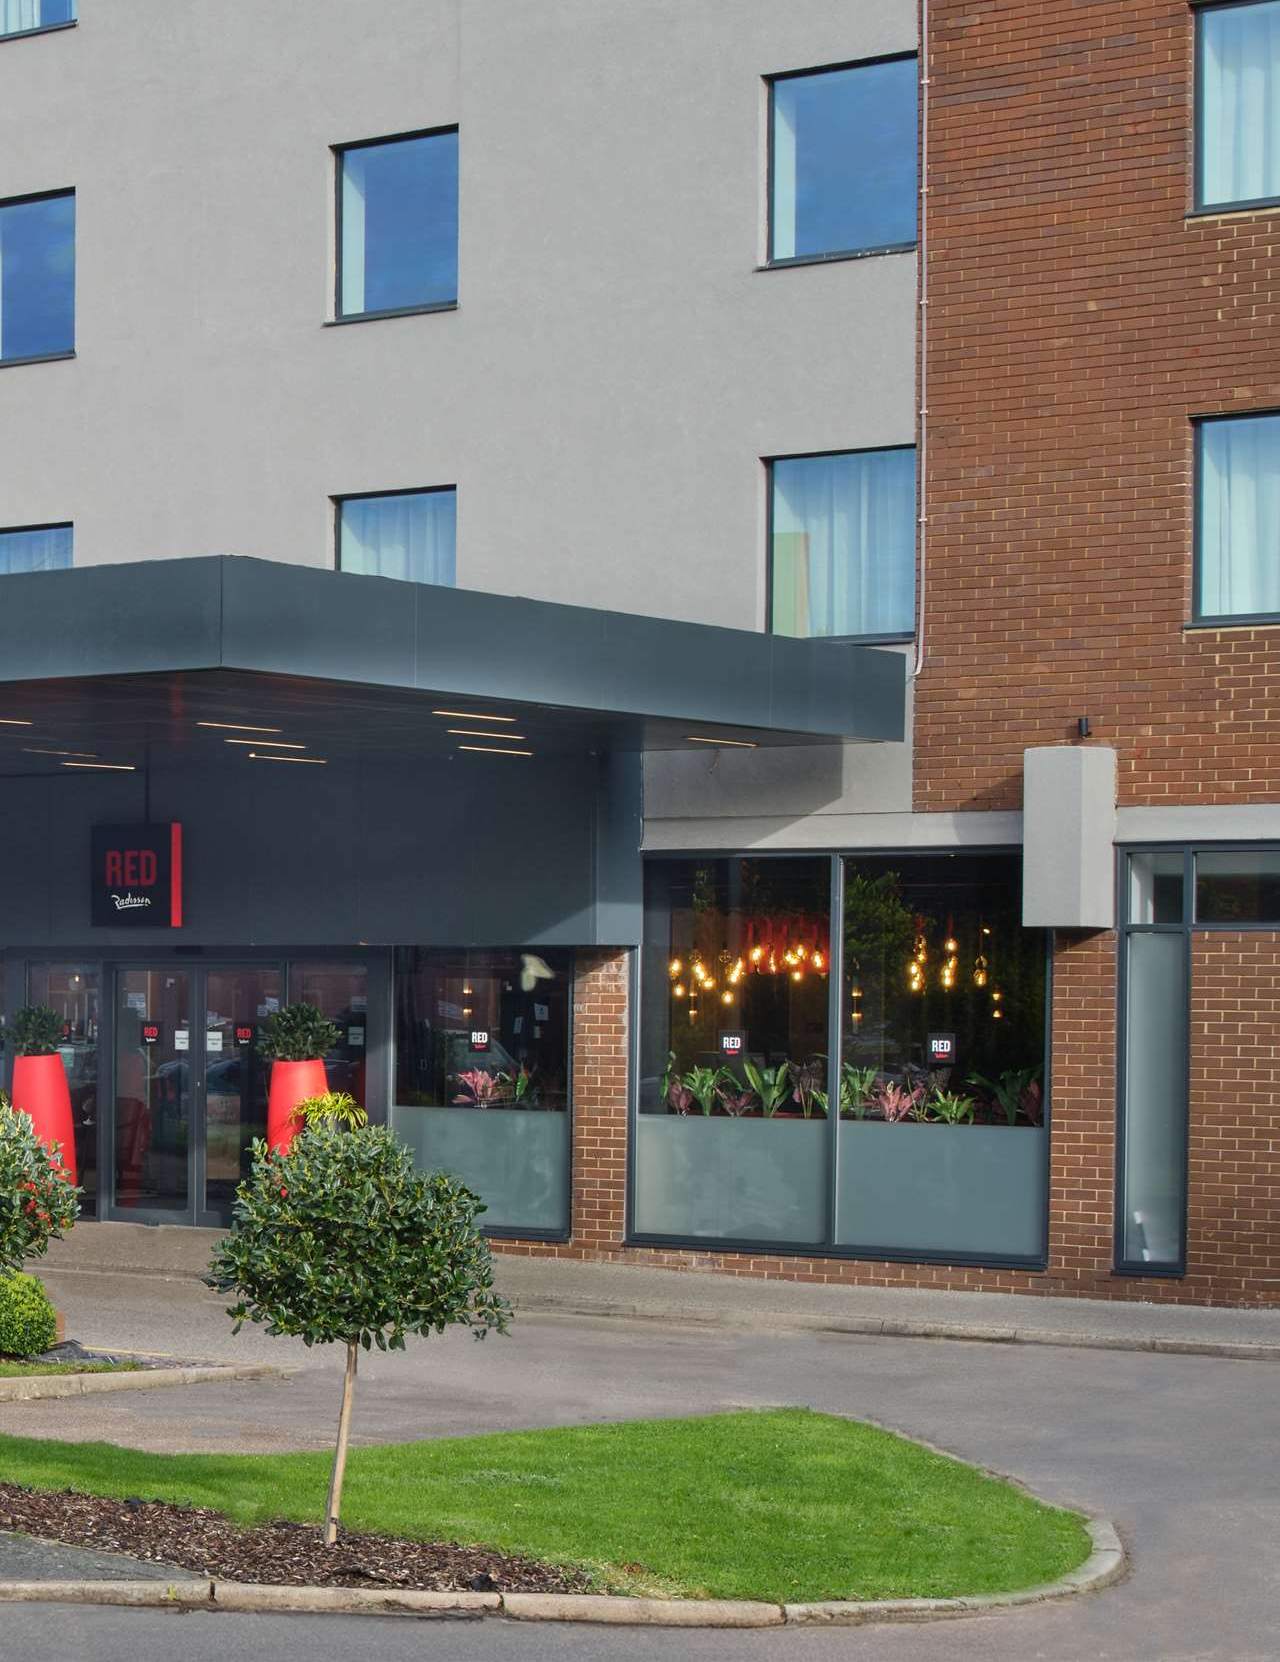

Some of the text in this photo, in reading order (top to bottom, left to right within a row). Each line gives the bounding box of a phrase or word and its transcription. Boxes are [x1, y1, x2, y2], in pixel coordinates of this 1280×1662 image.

[105, 849, 158, 886] RED
[111, 892, 151, 910] Radisson
[144, 1026, 158, 1037] RED
[236, 1028, 251, 1038] RED
[471, 1032, 488, 1043] RED
[723, 1037, 740, 1048] RED
[931, 1040, 951, 1052] RED
